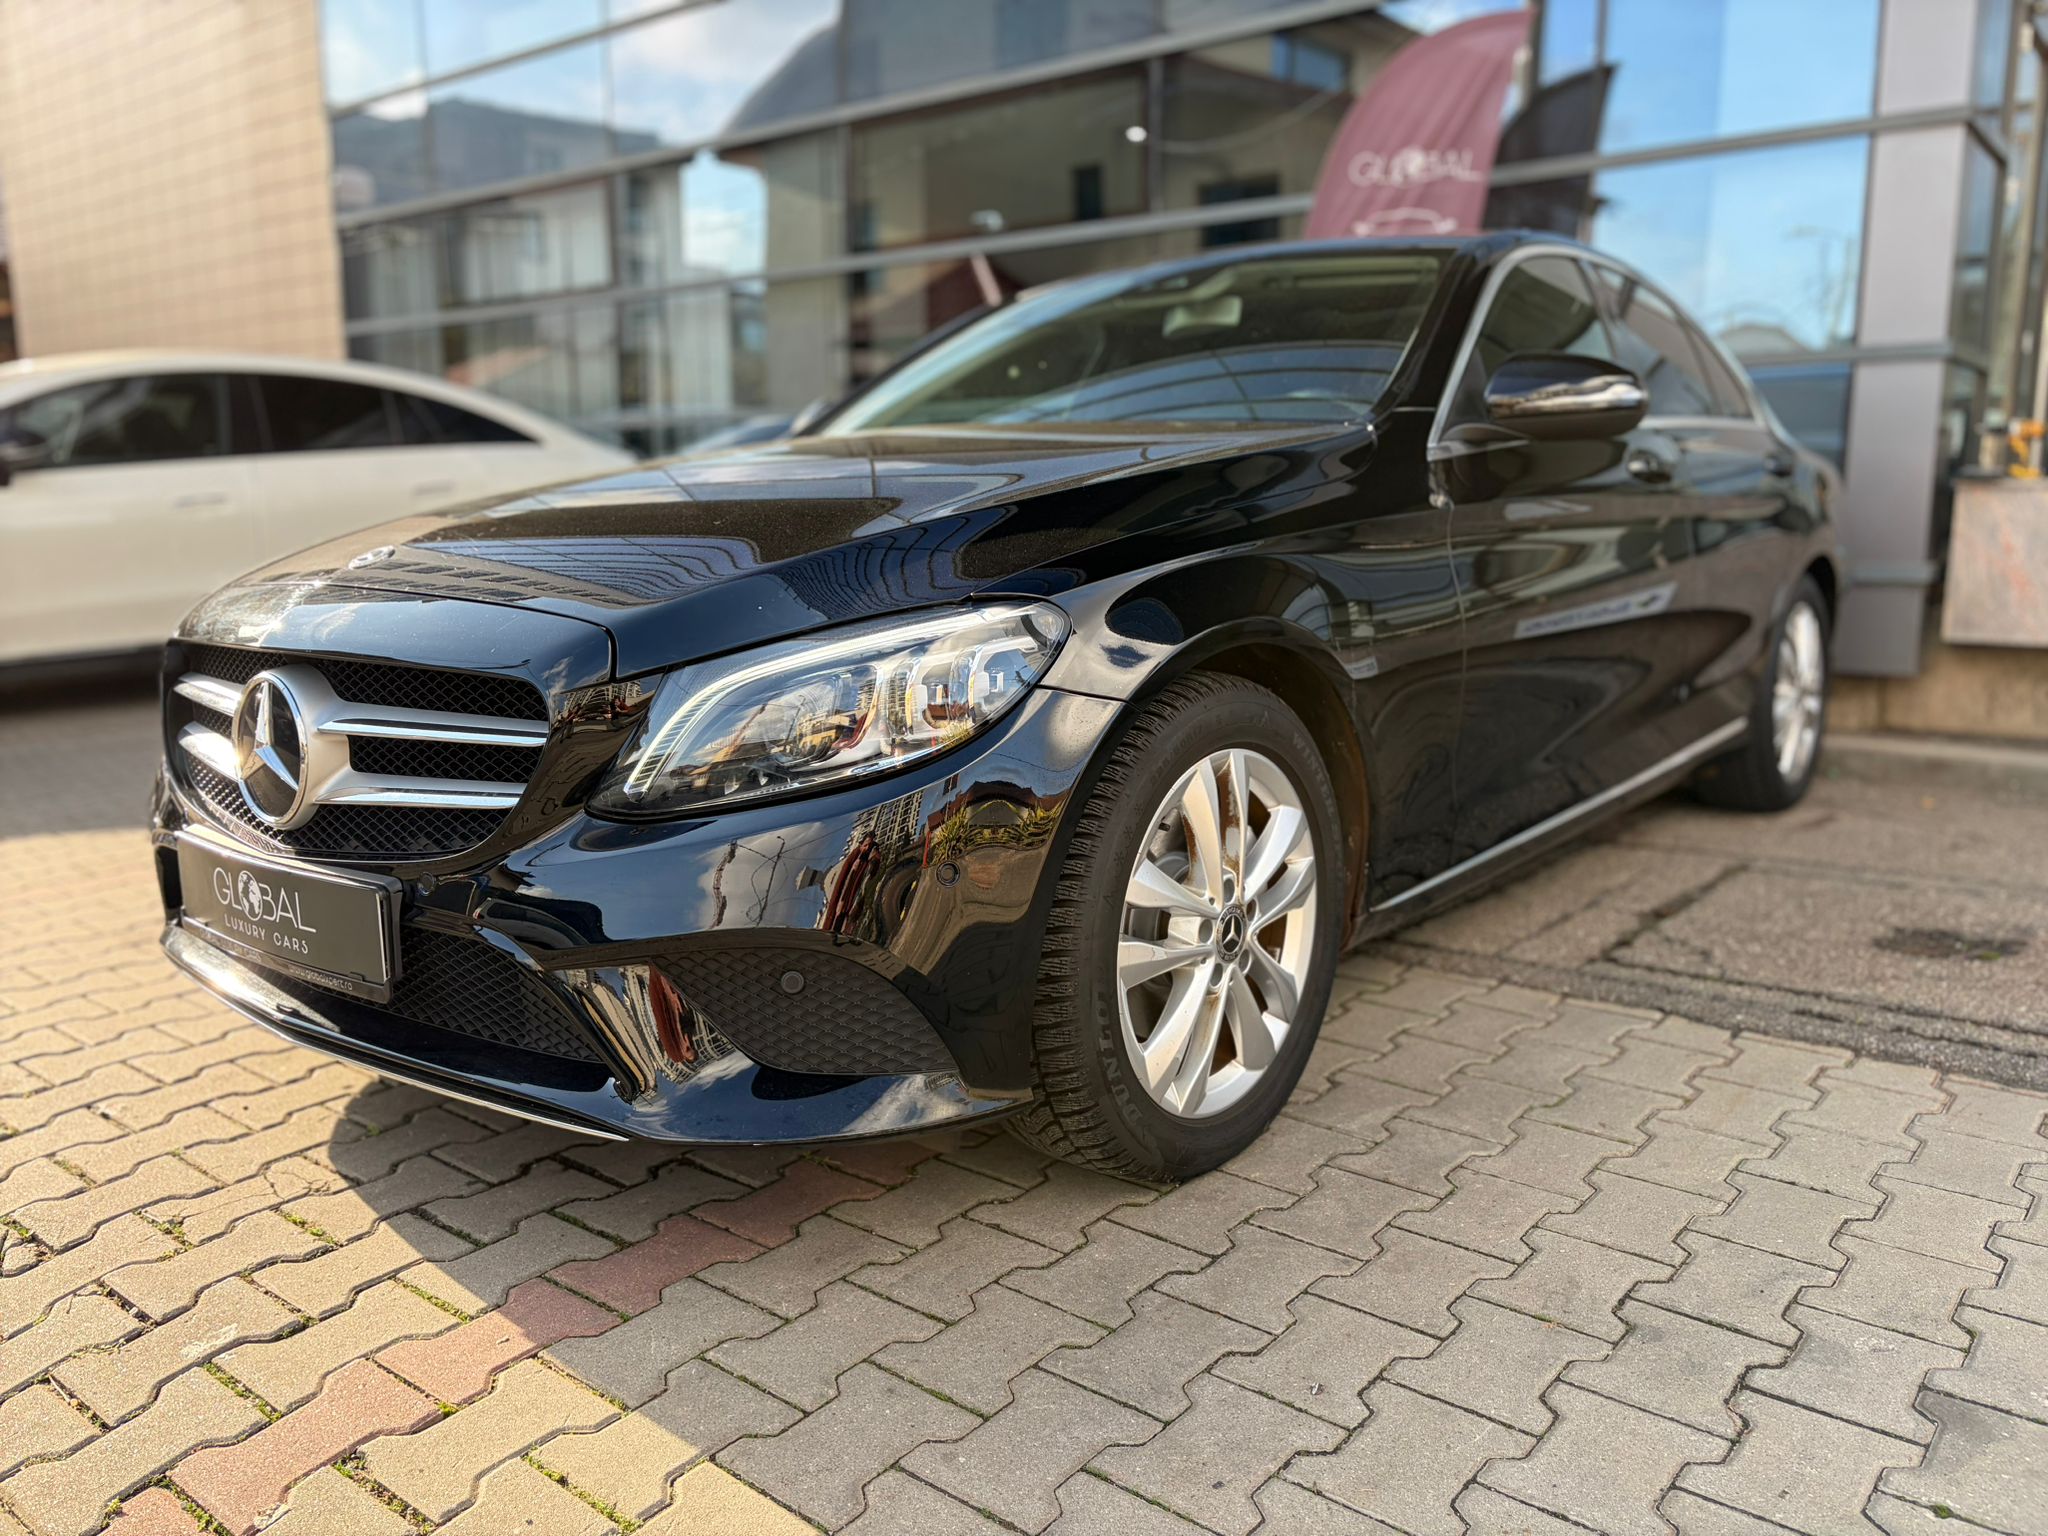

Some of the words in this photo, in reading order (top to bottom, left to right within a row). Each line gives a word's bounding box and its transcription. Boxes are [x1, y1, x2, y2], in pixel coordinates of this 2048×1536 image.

[1347, 146, 1483, 188] GLOBAL
[213, 866, 317, 934] GLOBAL
[223, 913, 266, 941] LUXURY
[273, 932, 309, 954] CARS
[1095, 982, 1143, 1127] DUNLO
